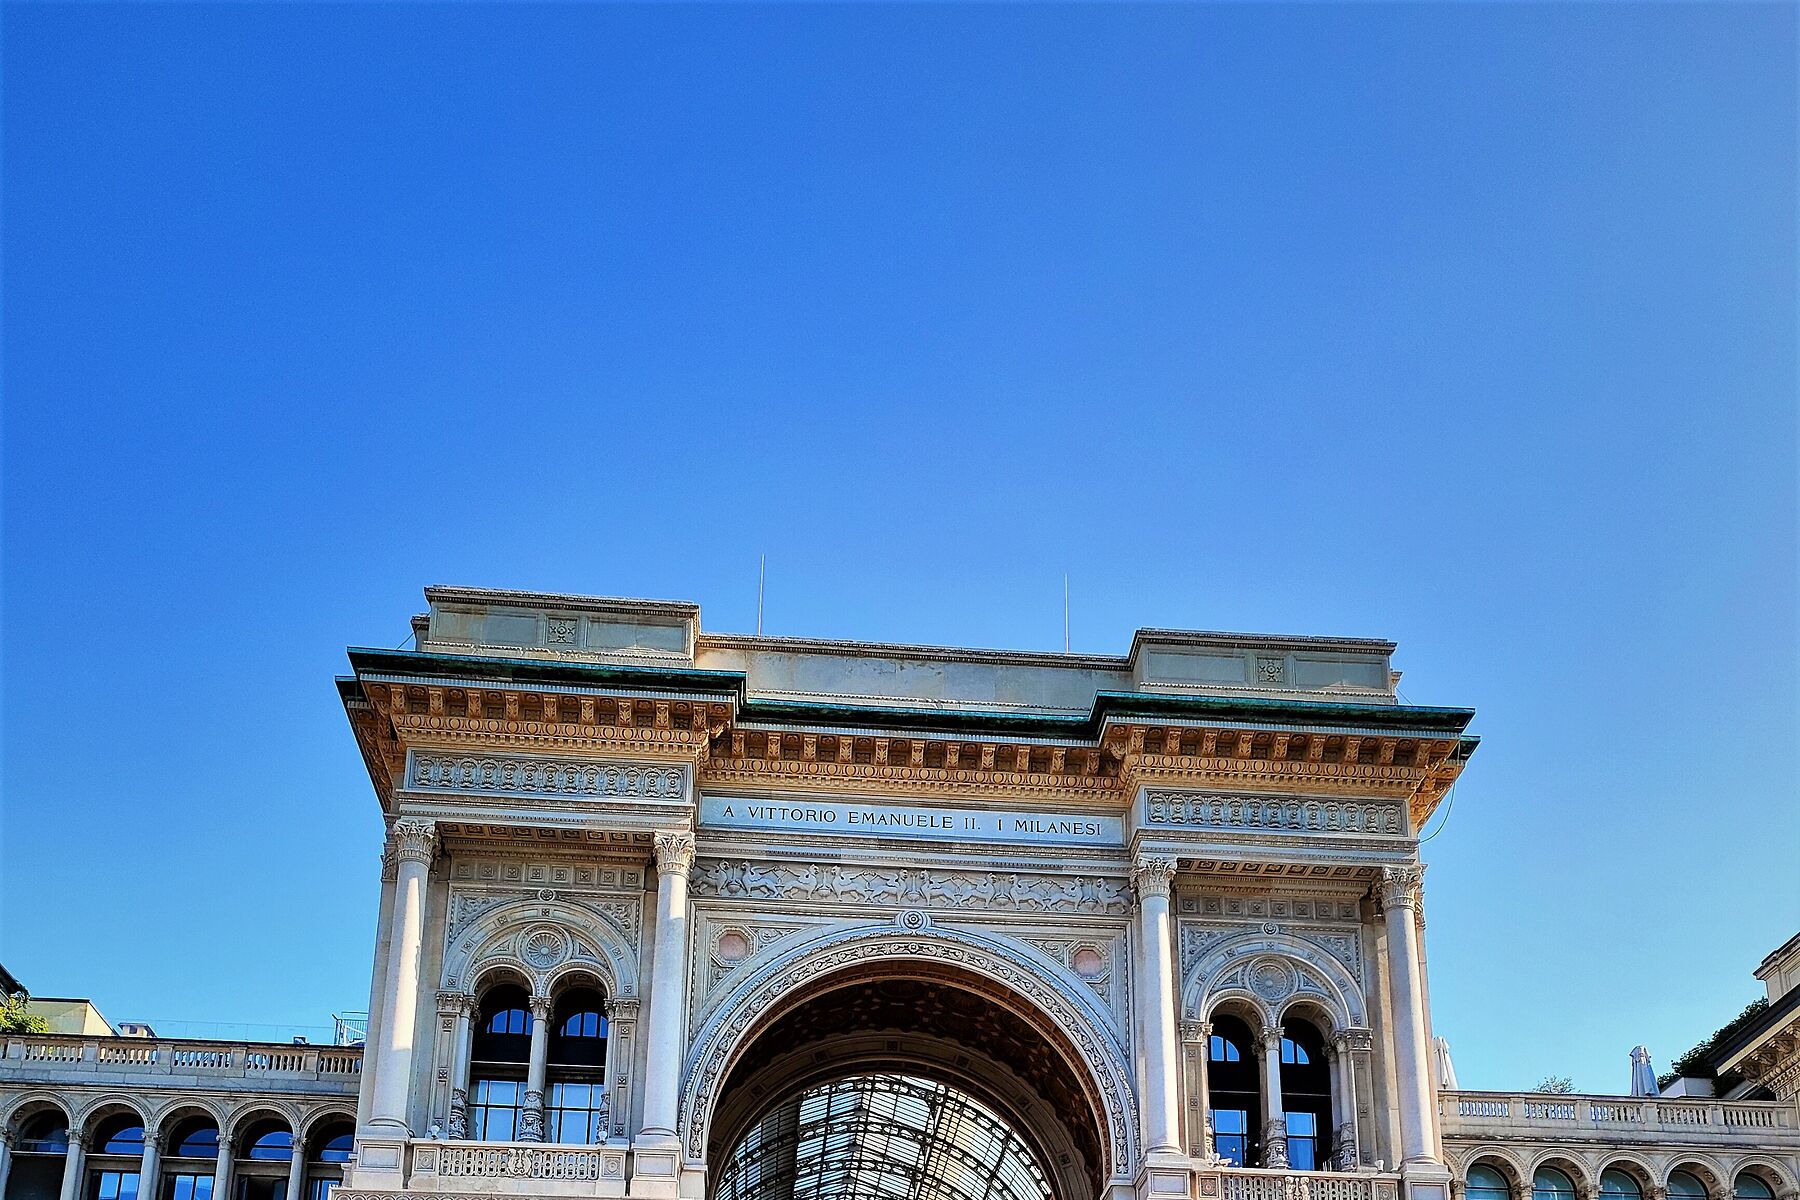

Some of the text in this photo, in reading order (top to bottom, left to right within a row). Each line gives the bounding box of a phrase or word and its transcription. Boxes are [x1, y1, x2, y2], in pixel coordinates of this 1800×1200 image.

[723, 805, 735, 818] A
[747, 806, 836, 823] VITTORIO
[847, 811, 953, 830] EMANUELE
[1014, 820, 1101, 836] MILANESI
